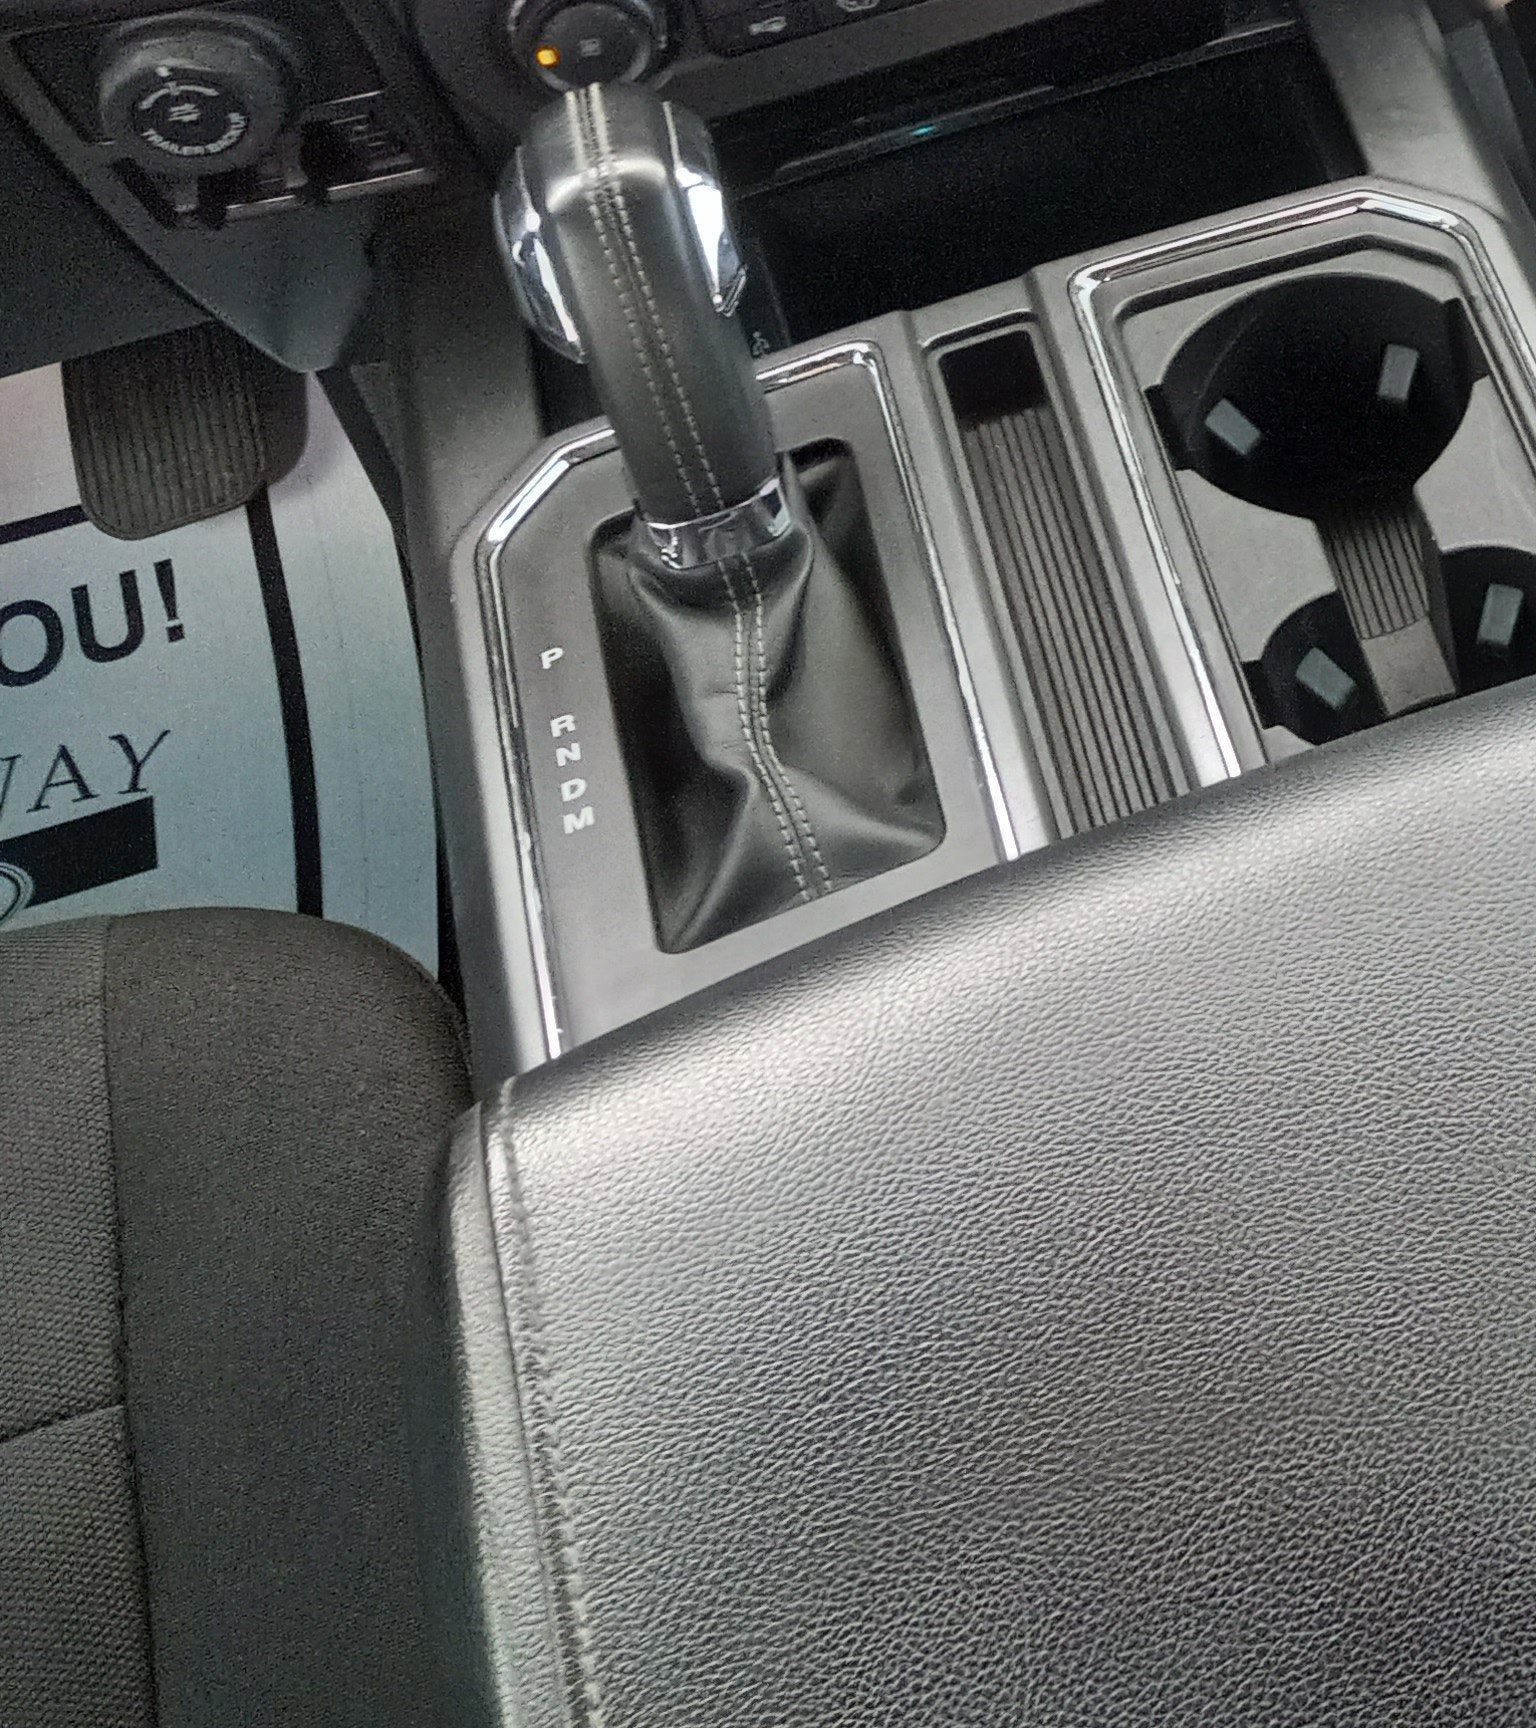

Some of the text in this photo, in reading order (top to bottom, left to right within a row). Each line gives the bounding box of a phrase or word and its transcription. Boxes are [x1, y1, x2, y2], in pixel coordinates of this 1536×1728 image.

[0, 558, 187, 688] OU!
[541, 647, 564, 670] P
[550, 714, 576, 738] R
[556, 742, 581, 767] N
[561, 778, 587, 802] D
[563, 805, 595, 834] M
